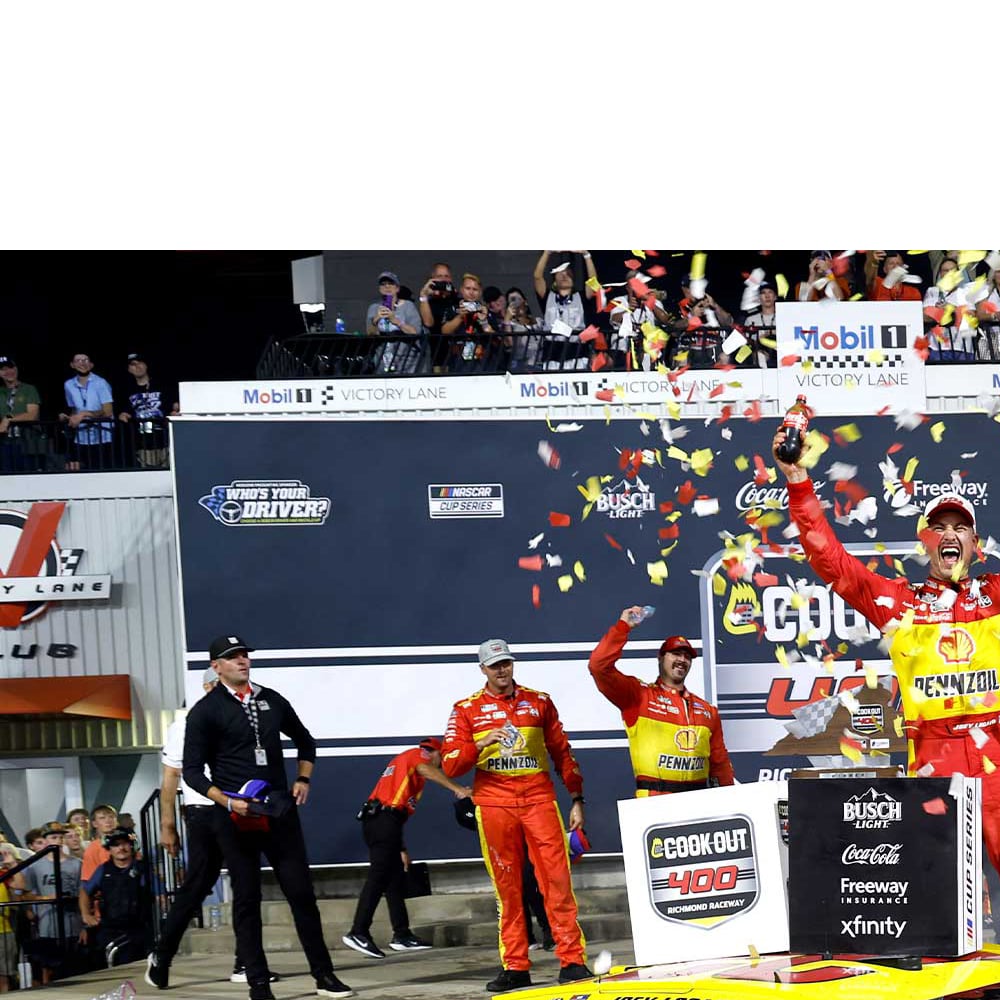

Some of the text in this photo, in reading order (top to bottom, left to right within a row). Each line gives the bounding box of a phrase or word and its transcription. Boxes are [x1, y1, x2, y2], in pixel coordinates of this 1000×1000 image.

[794, 325, 874, 350] Mobil
[796, 373, 909, 387] VICTORY LANE
[243, 389, 292, 404] Mobil
[341, 388, 404, 401] VICTORY
[408, 386, 446, 399] LANE
[520, 382, 569, 397] Mobil
[226, 488, 307, 500] WHO'S YOUR
[452, 487, 491, 497] NASCAR
[242, 501, 328, 518] DRIVER?
[440, 501, 492, 511] CUP SERIES
[597, 493, 655, 511] BUSCH
[609, 510, 643, 518] LIGHT
[36, 582, 104, 594] LANE
[0, 642, 78, 660] UB
[914, 670, 1000, 698] PENNZOIL
[843, 801, 902, 820] BUSCH
[856, 820, 889, 828] LIGHT
[841, 844, 903, 865] Coca-Cola
[668, 865, 739, 894] 400
[841, 878, 908, 896] Freeway
[667, 898, 745, 915] RICHMOND RACEWAY
[841, 915, 907, 938] xfinity
